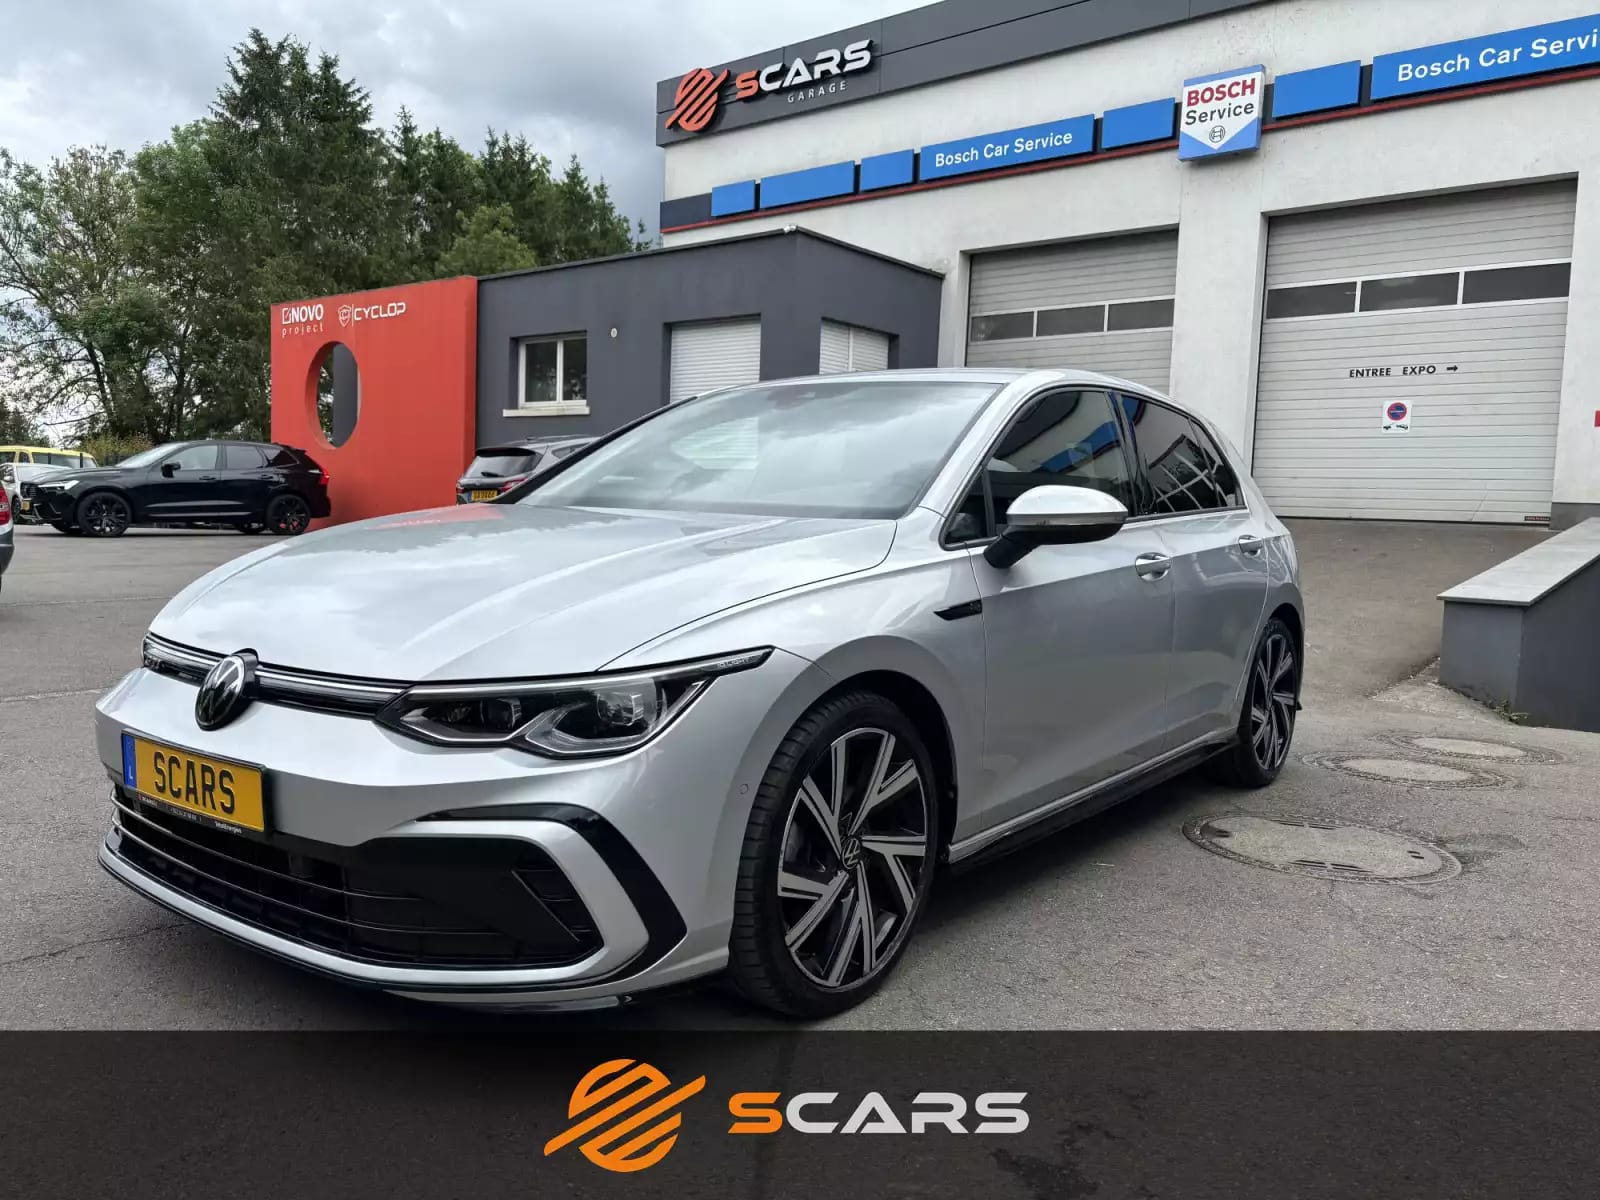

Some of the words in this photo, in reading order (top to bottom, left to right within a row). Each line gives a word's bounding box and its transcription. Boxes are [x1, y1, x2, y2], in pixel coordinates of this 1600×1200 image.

[1397, 53, 1470, 82] Bosch
[1479, 46, 1522, 67] Car
[1530, 28, 1599, 58] Servi
[735, 39, 871, 100] SCARS
[787, 80, 847, 103] GARAGE
[1187, 77, 1256, 106] BOSCH
[1185, 102, 1254, 126] Service
[935, 146, 979, 167] Bosch
[983, 143, 1009, 158] Car
[1013, 132, 1073, 153] Service
[353, 302, 406, 321] CYCLOP
[282, 323, 324, 339] project
[1349, 367, 1392, 378] ENTREE
[1402, 365, 1437, 376] EXPO
[154, 750, 236, 815] SCARS
